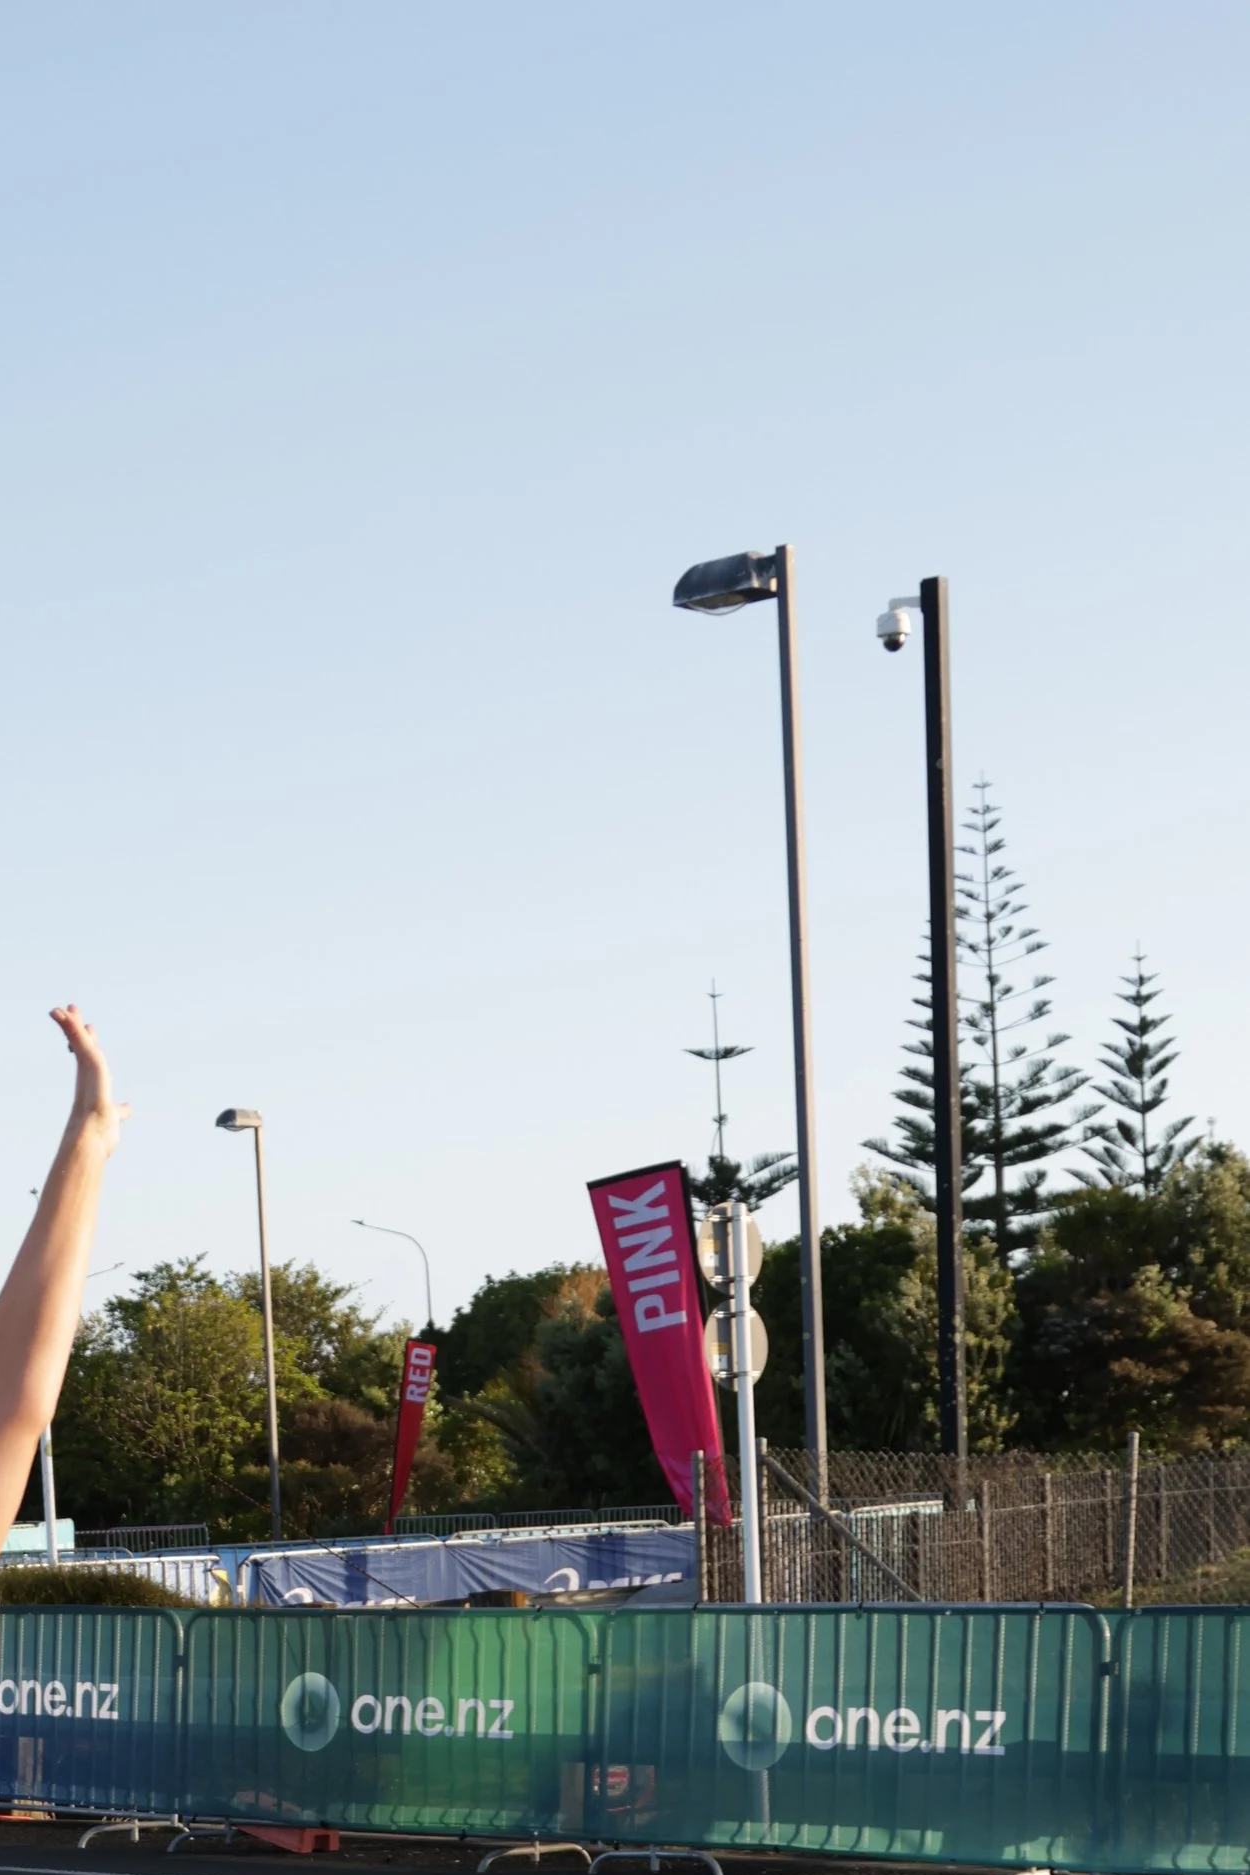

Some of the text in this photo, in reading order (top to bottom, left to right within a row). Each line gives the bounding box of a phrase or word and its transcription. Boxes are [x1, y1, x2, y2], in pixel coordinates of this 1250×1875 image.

[608, 1180, 688, 1333] PINK
[406, 1347, 432, 1402] RED
[351, 1694, 515, 1739] one.nz
[805, 1705, 1006, 1755] one.nz
